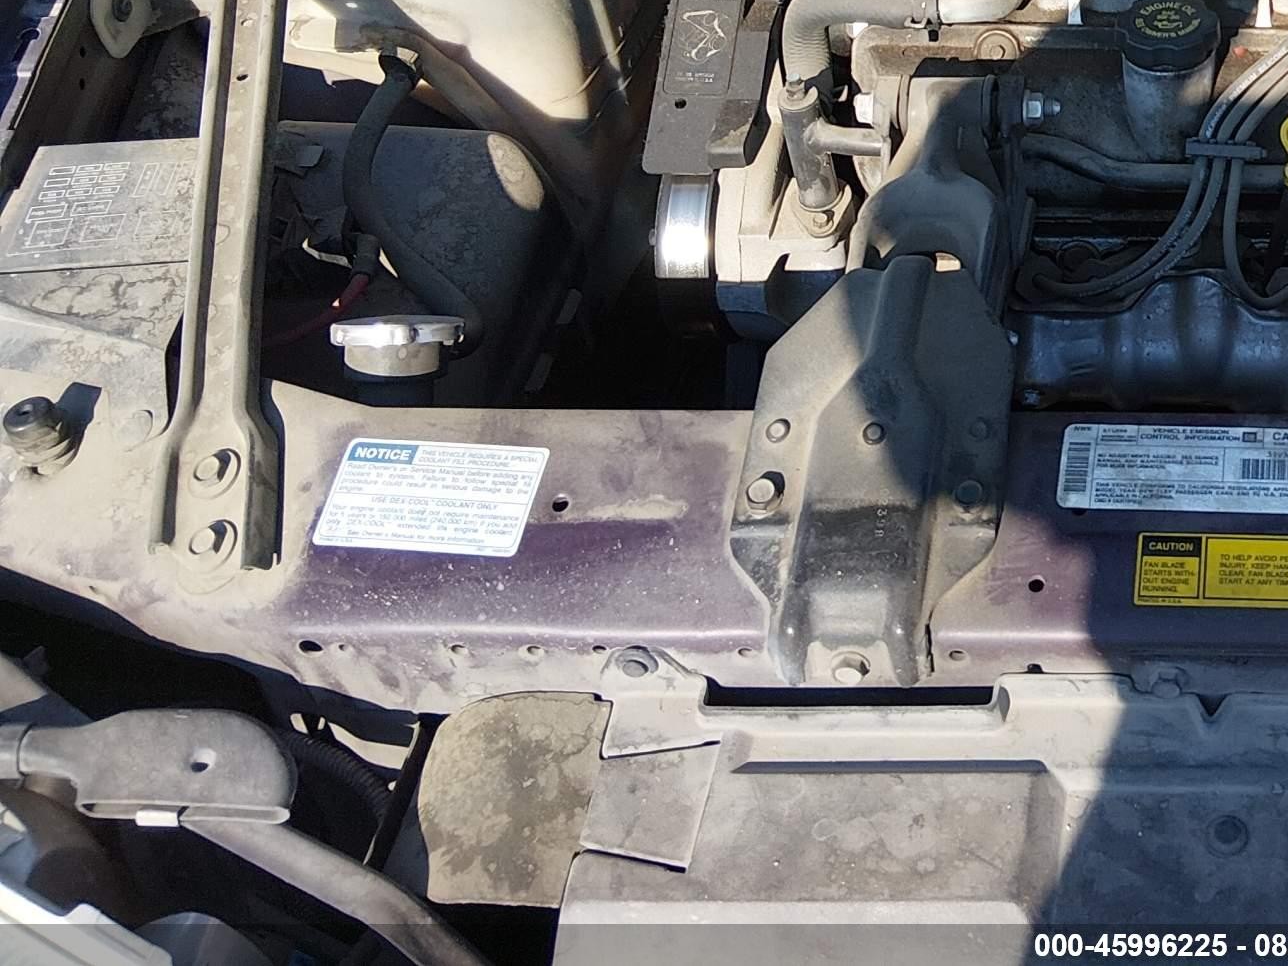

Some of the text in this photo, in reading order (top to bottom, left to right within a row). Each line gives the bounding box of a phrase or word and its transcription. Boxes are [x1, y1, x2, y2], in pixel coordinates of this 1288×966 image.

[1140, 1, 1182, 16] ENGINE
[1189, 428, 1231, 436] EMISSION
[1140, 433, 1181, 441] CONTROL
[1184, 434, 1241, 443] INFORMATION
[354, 446, 412, 461] NOTICE
[439, 467, 466, 476] Manual
[492, 472, 519, 481] adding
[435, 499, 475, 509] COOLANT
[1148, 541, 1195, 552] CAUTION
[1220, 553, 1231, 561] TO
[1232, 554, 1252, 562] HELP
[1254, 554, 1278, 562] AVOID
[1143, 560, 1186, 569] FAN BLADE
[1250, 562, 1272, 570] KEEP
[1142, 568, 1172, 576] STARTS
[1248, 570, 1264, 578] FAN
[1160, 577, 1190, 585] ENGINE
[1218, 577, 1242, 585] START
[1256, 578, 1273, 586] ANY
